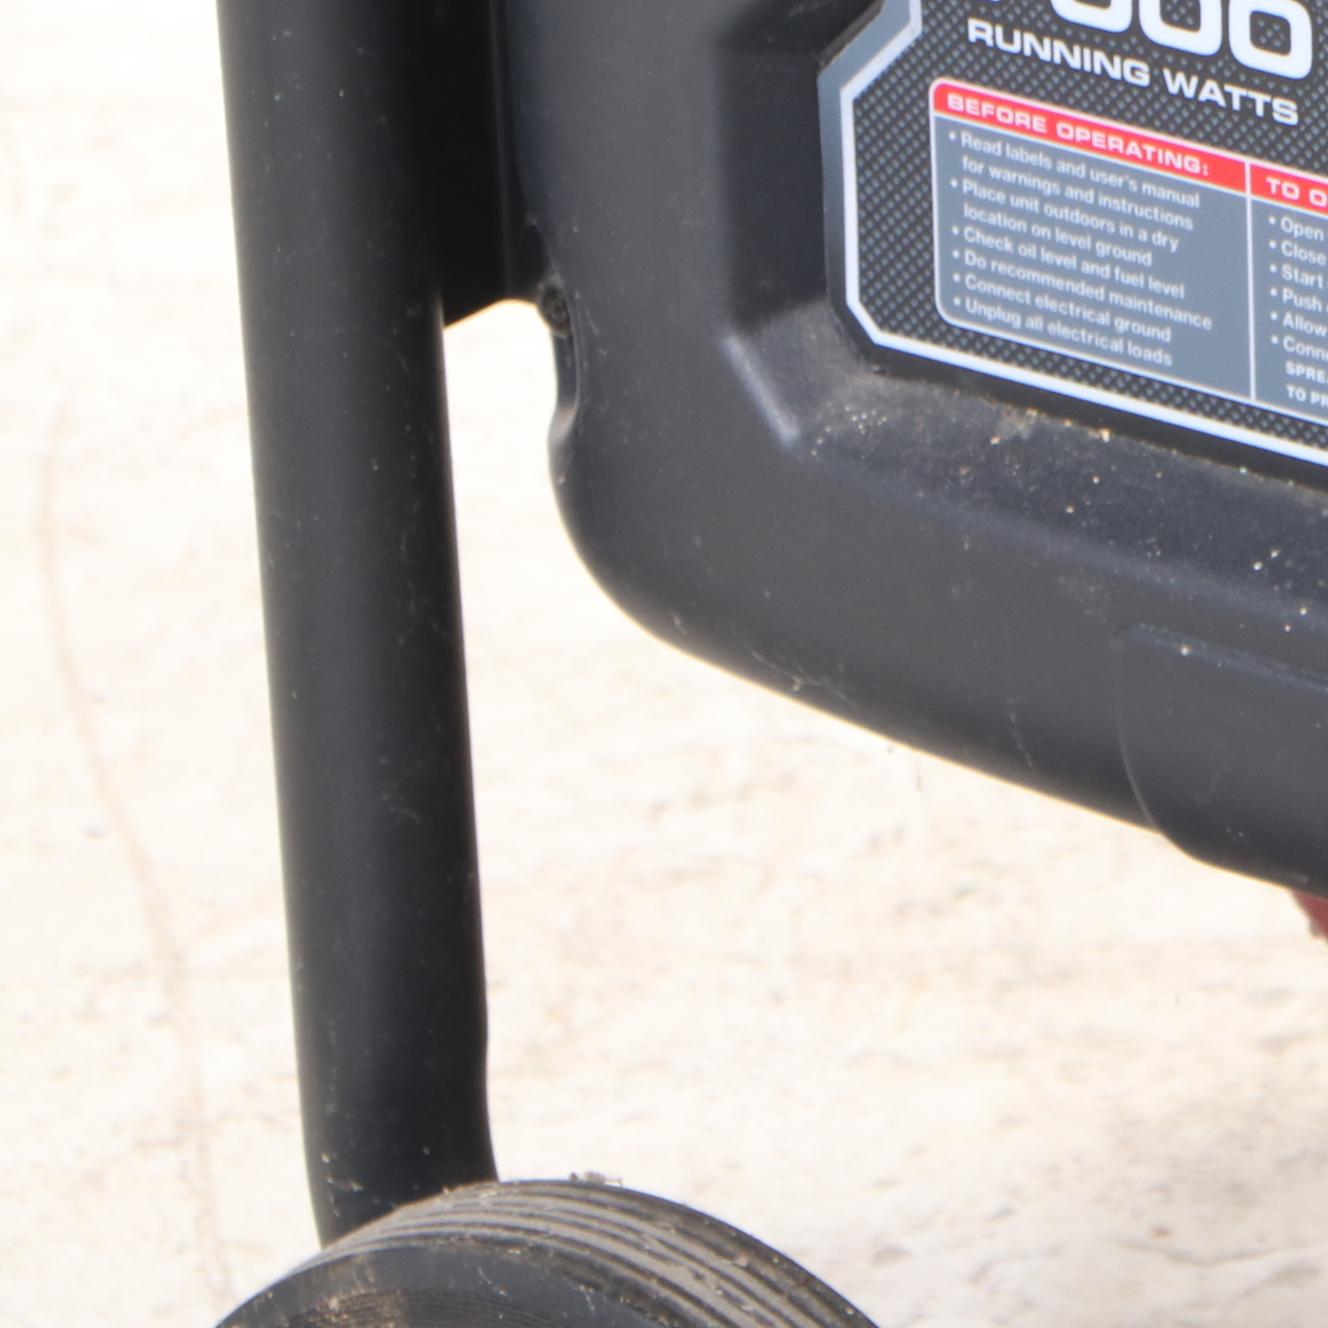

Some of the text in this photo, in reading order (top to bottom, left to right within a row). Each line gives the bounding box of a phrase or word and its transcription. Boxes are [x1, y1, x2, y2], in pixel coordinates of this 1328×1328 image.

[968, 18, 1298, 126] RUNNING WATTS
[948, 94, 1209, 176] BEFORE OPERATING:
[1266, 177, 1300, 200] TO
[1281, 216, 1324, 243] Open
[1286, 385, 1305, 402] TO
